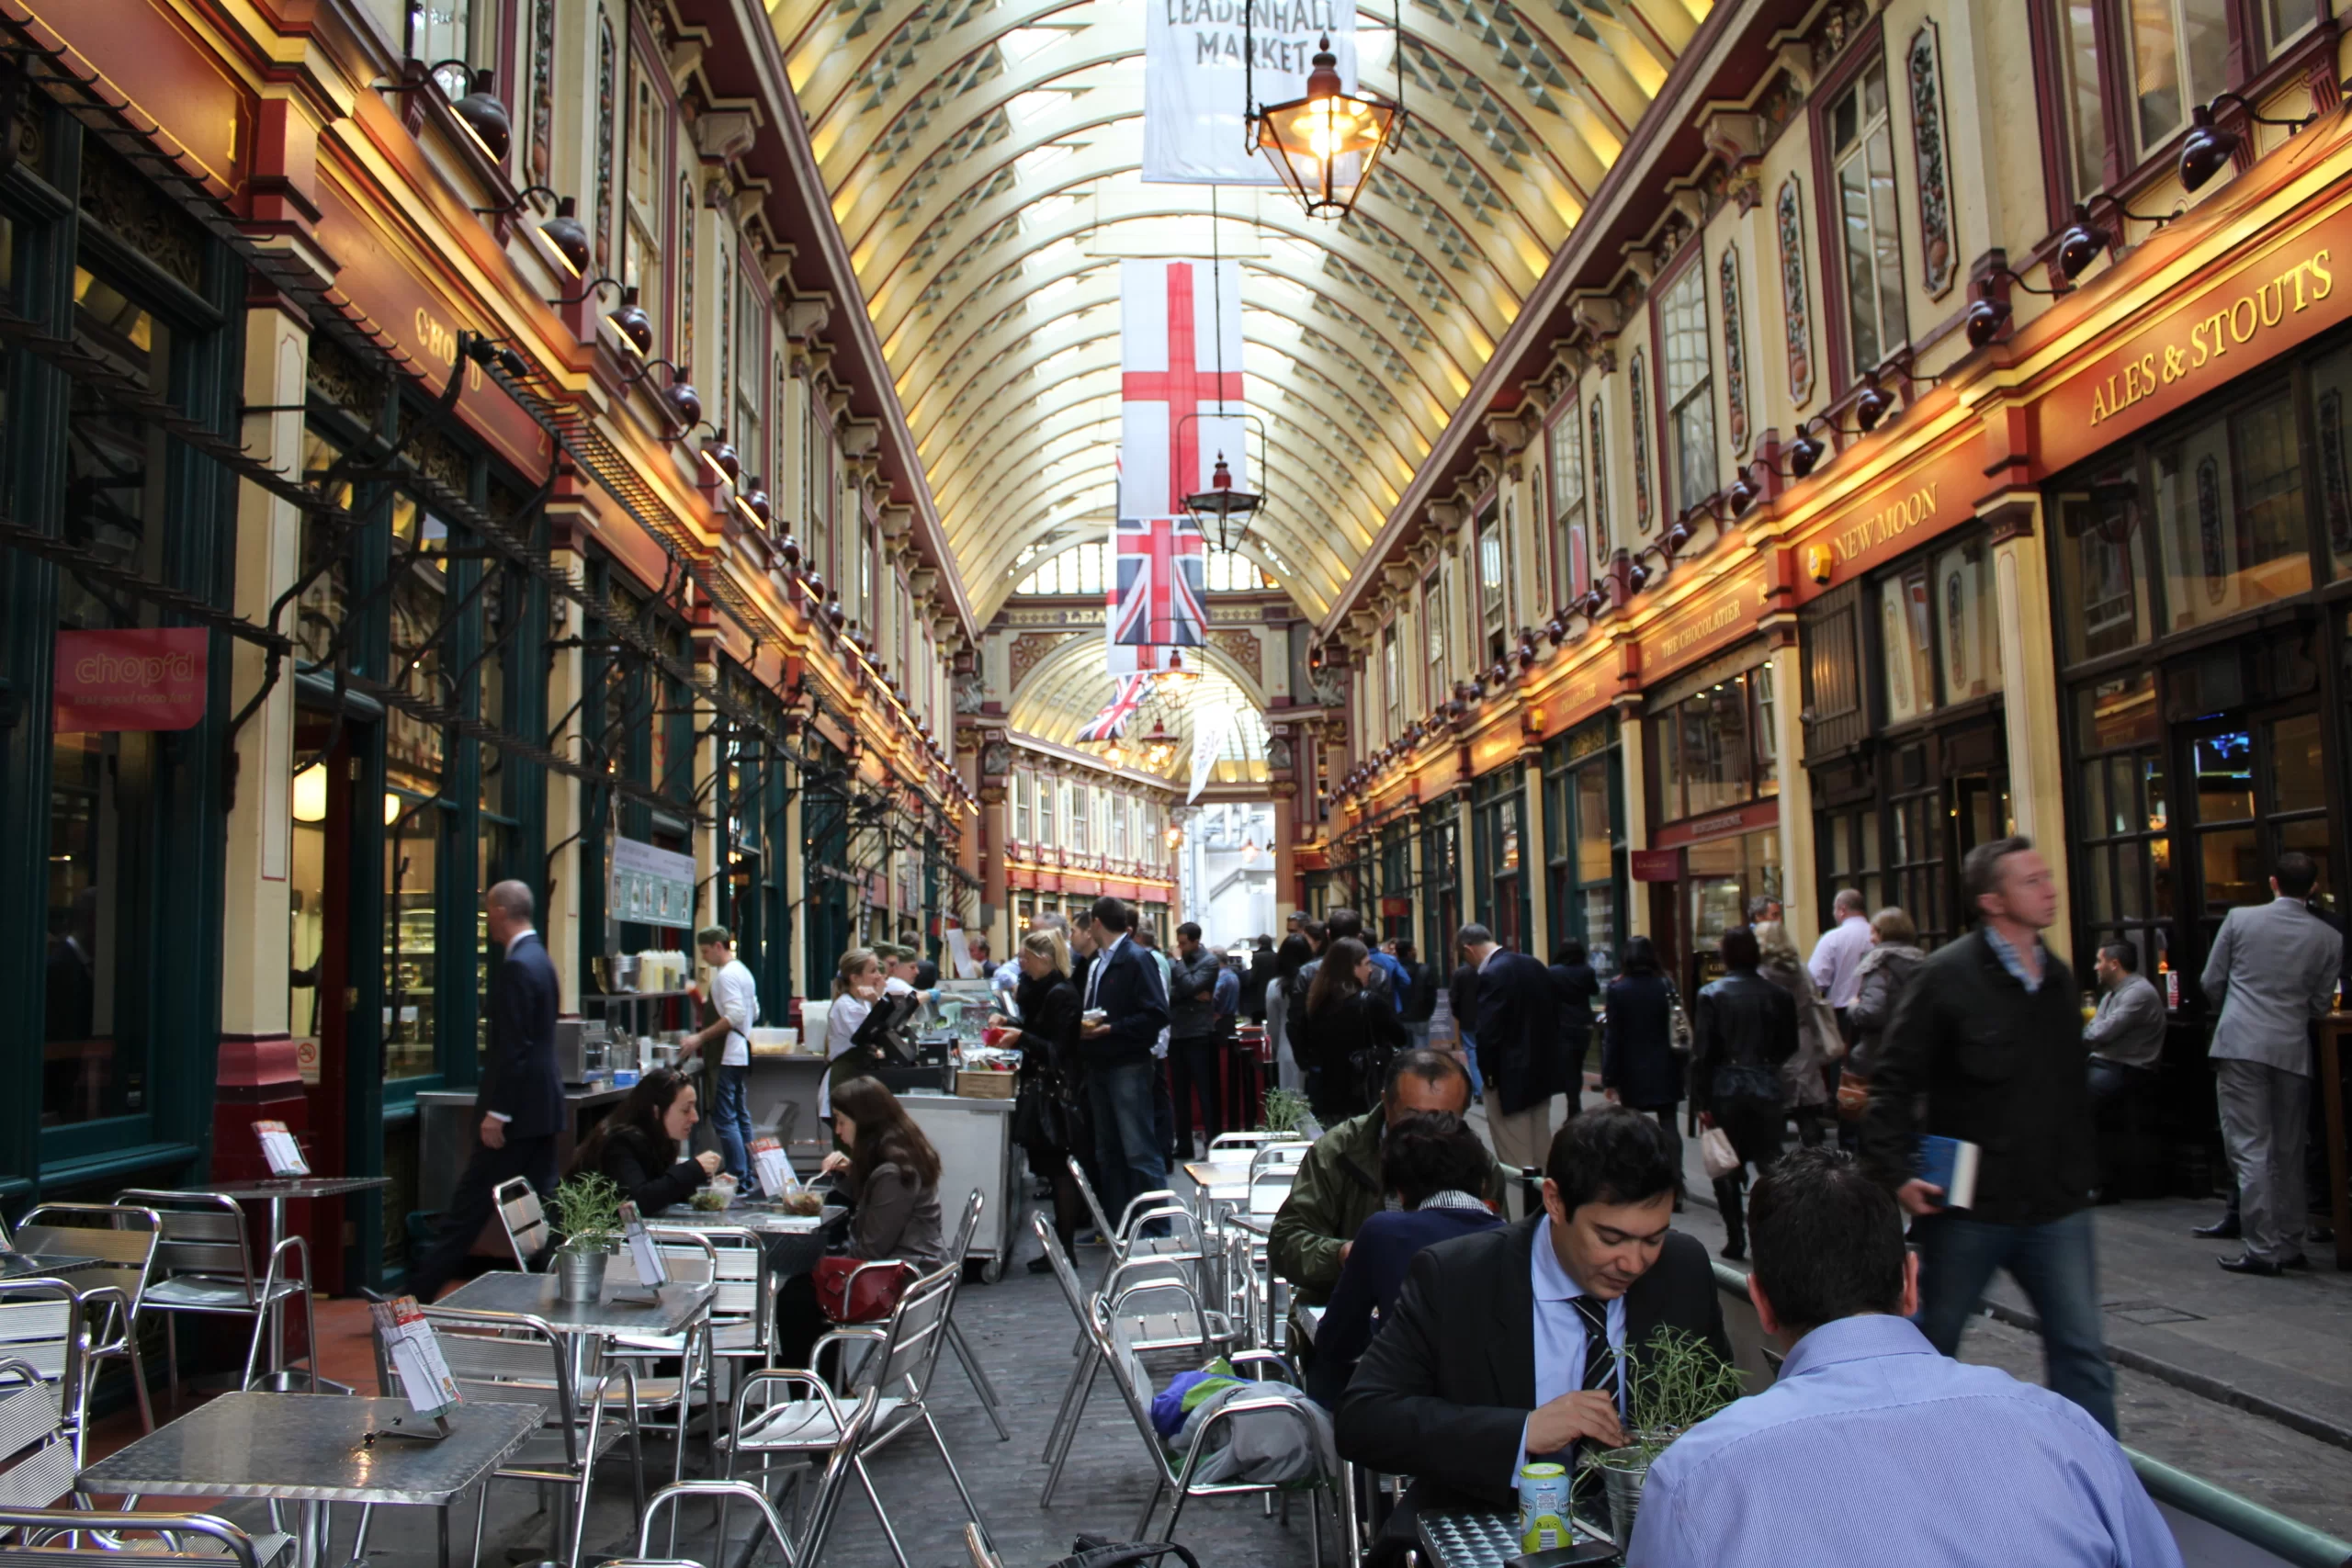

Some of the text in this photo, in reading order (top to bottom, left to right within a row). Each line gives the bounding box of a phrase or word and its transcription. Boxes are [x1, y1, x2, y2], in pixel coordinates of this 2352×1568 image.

[1168, 0, 1338, 33] LEADENHALL
[1196, 31, 1308, 74] MARKET
[415, 306, 481, 392] CHOD
[2090, 249, 2333, 426] ALES & STOUTS
[1834, 481, 1937, 567] NEW MOON
[1661, 636, 1679, 659] THE
[1679, 599, 1741, 649] CHOCOLATIER
[75, 652, 195, 688] chop'd
